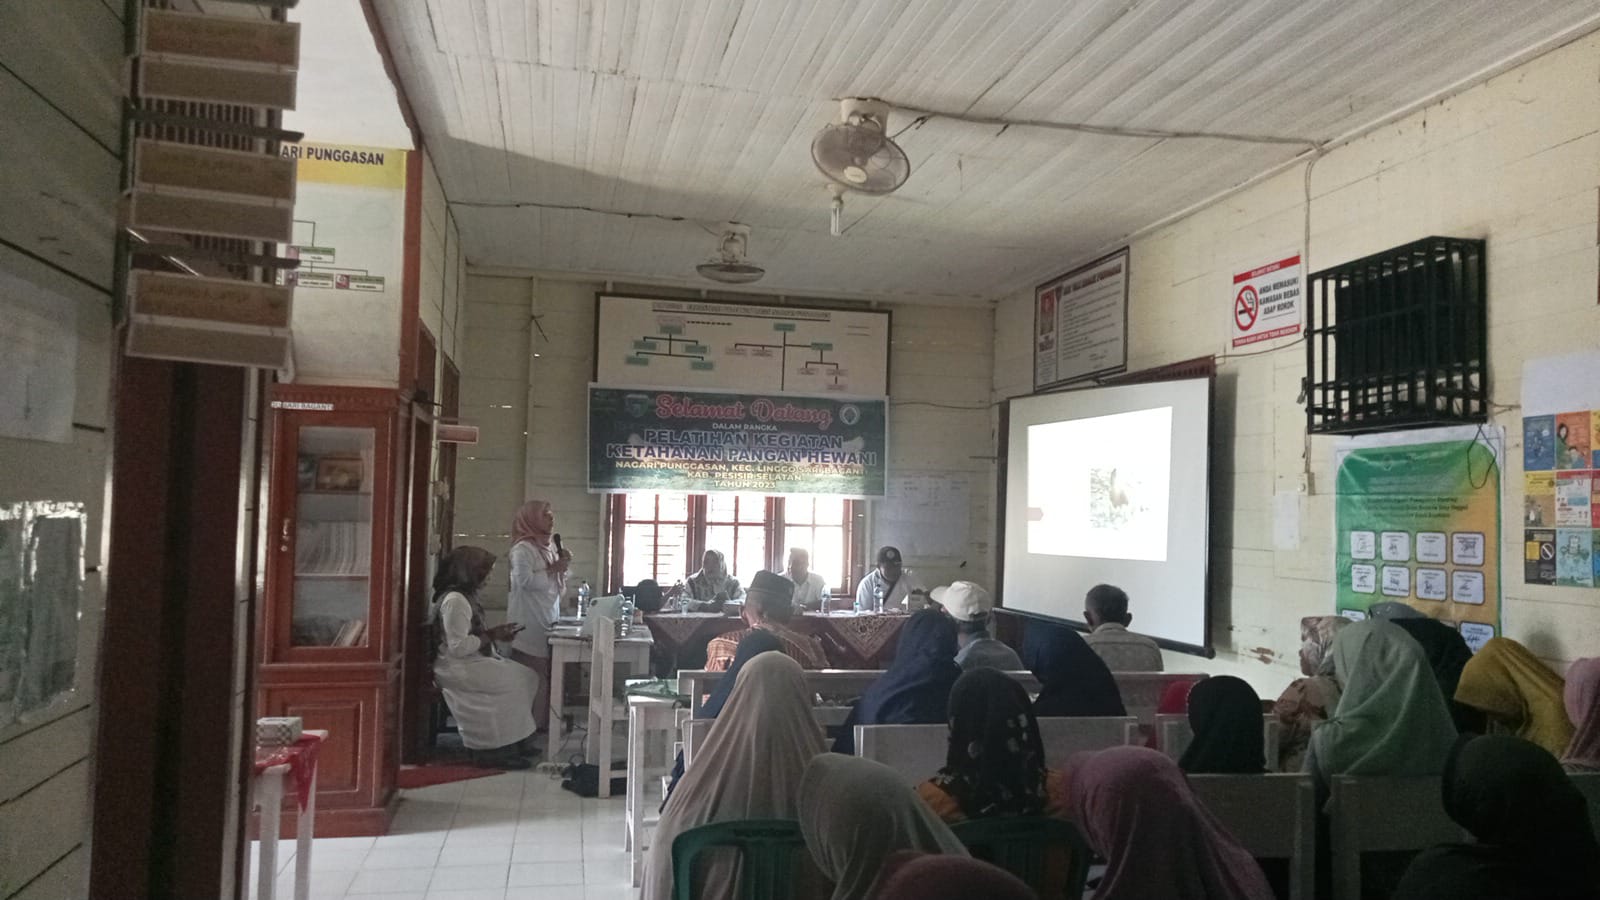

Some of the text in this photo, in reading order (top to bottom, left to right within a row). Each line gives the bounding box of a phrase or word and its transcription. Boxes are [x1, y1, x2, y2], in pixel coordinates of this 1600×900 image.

[307, 147, 384, 165] PUNGGASAN
[1259, 277, 1299, 295] ANDA MEMASUKI
[1259, 288, 1300, 305] KAWASAN BEBAS
[1263, 301, 1295, 315] ASAP ROKOK
[656, 394, 832, 430] Selamat Datang
[712, 423, 742, 431] DALAM
[644, 429, 843, 449] PELATIHAN KEGIATAN
[606, 444, 876, 466] KETAHANAN PANGAN HEWANI
[615, 461, 656, 469] NAGARI
[758, 465, 796, 473] LINGGO
[714, 480, 751, 488] TAHUN
[715, 472, 754, 480] PESISIR
[756, 473, 801, 481] SELATAN
